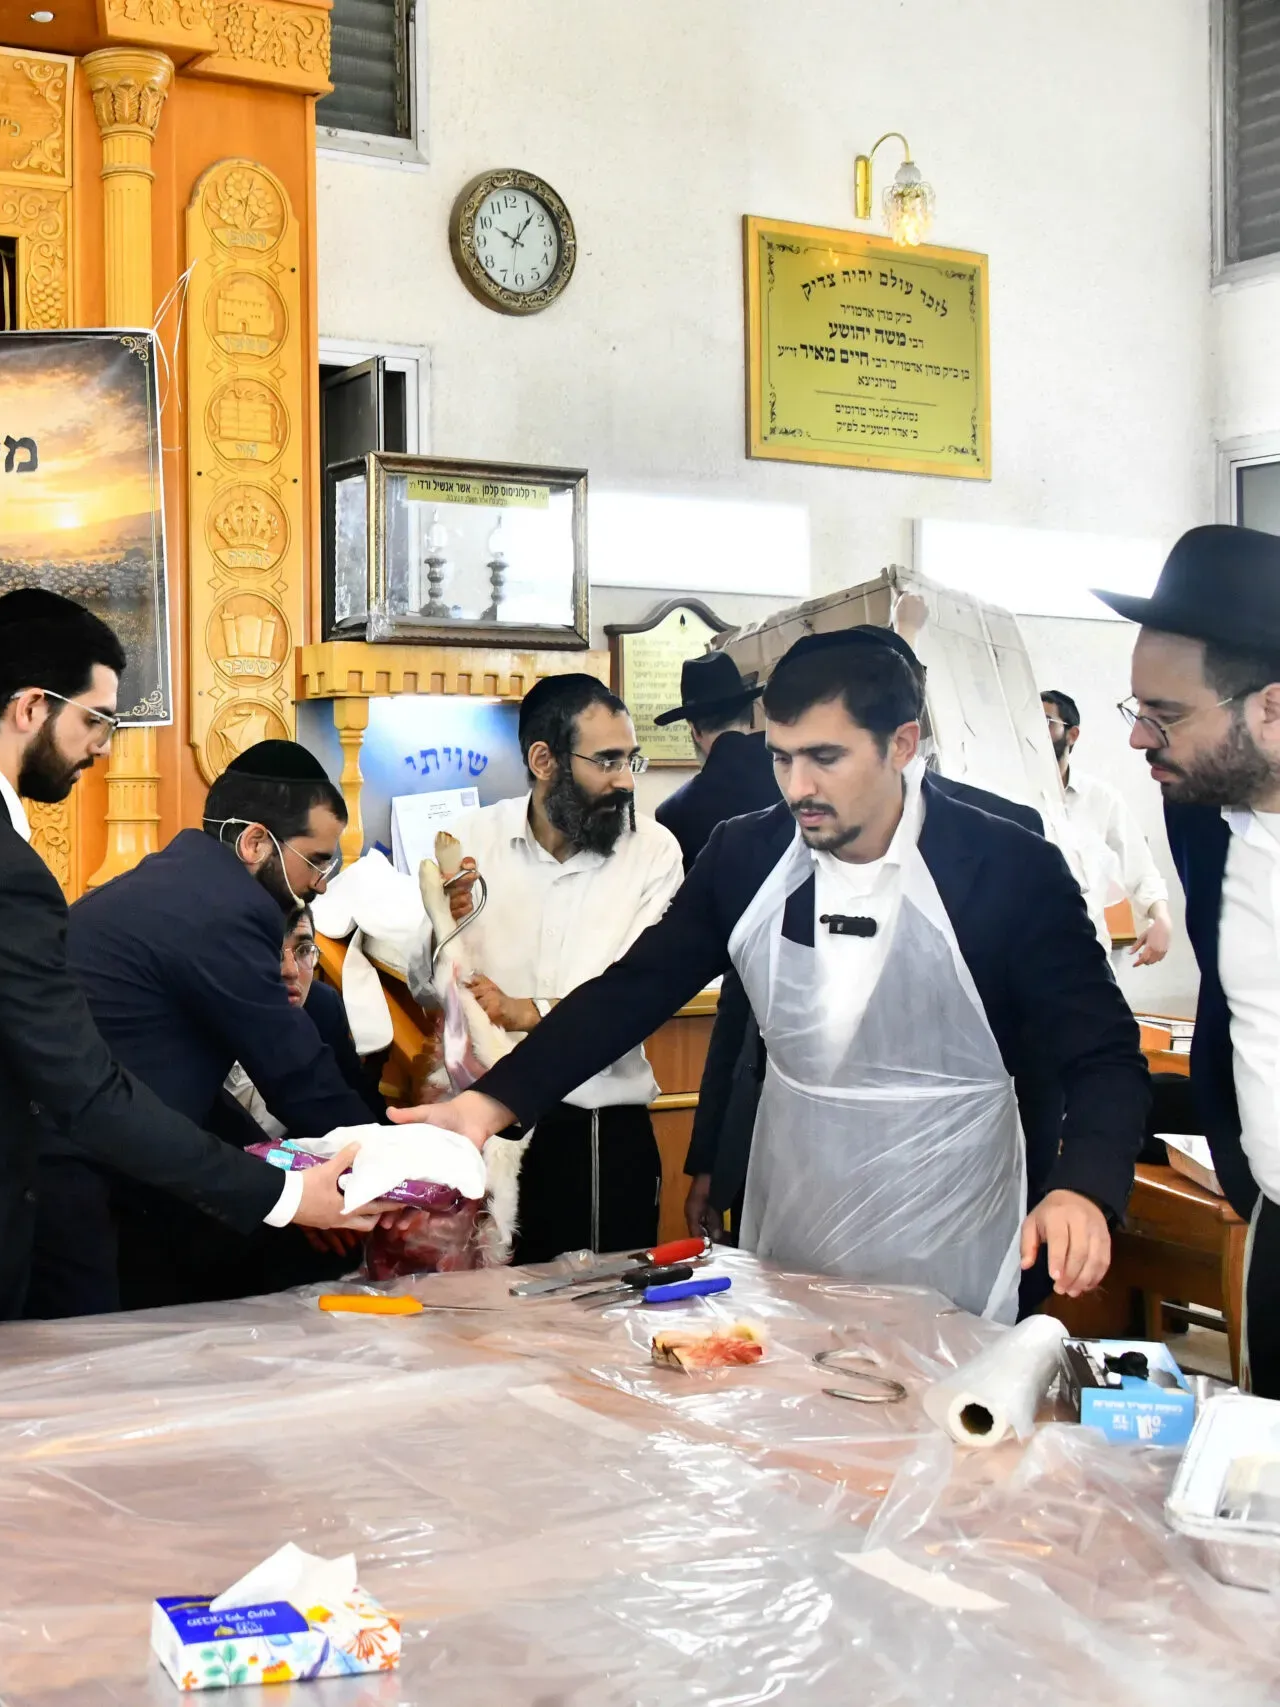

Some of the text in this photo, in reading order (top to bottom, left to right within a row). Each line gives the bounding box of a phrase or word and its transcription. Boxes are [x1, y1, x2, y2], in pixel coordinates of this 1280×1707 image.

[491, 201, 501, 214] 11
[504, 195, 517, 208] 12
[480, 216, 492, 229] 10
[537, 215, 545, 227] 2
[476, 235, 487, 248] 9
[544, 234, 552, 247] 3
[485, 254, 495, 268] 8
[500, 269, 508, 282] 7
[531, 267, 540, 281] 5
[801, 268, 948, 317] לזכר עולם יהיה צדיק
[829, 322, 870, 340] יהושע
[875, 328, 906, 346] משה
[800, 343, 836, 362] מאיר
[840, 348, 869, 366] חיים
[456, 483, 471, 494] אשר
[405, 746, 488, 777] שויתי
